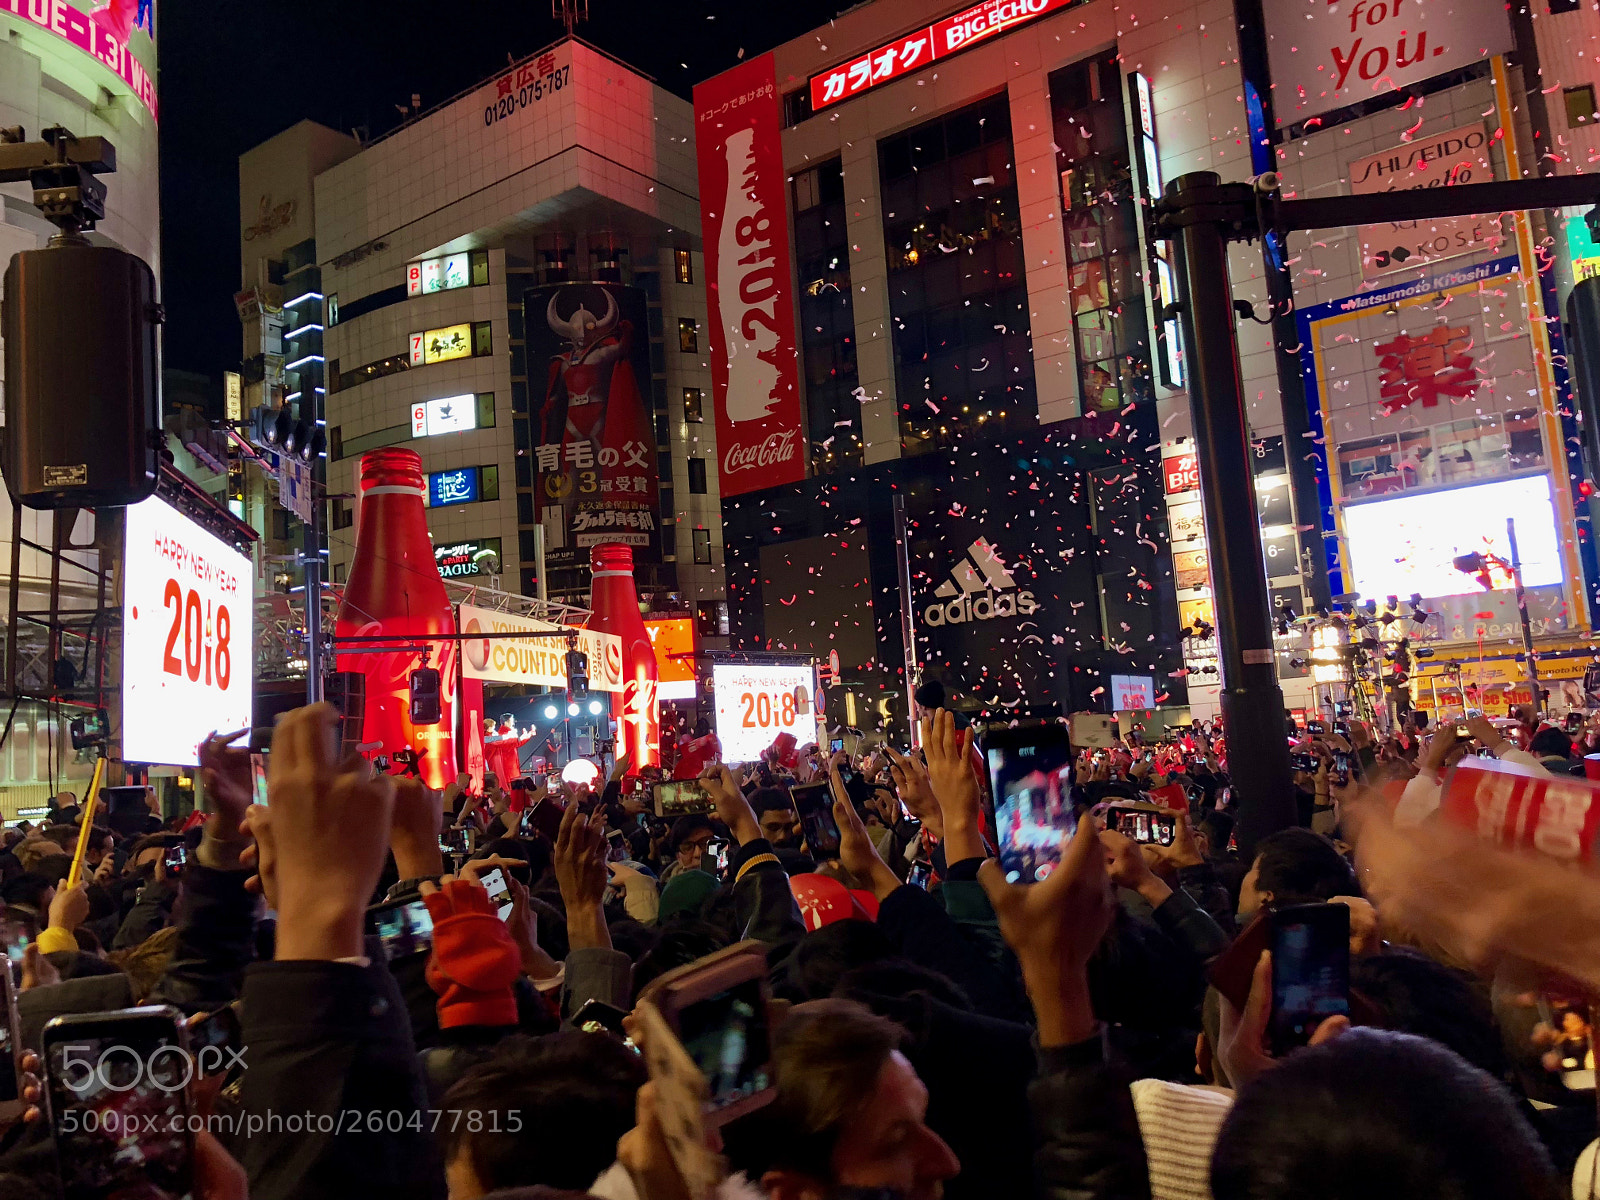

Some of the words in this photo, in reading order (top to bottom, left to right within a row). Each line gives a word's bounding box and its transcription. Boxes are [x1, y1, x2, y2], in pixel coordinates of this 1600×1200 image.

[946, 16, 986, 50] BIG
[988, 0, 1049, 26] ECHO
[496, 53, 556, 99] 貸広告
[822, 38, 926, 102] カラオケ
[485, 64, 570, 126] 0120-075-787
[1353, 132, 1484, 184] SHISEIDO
[535, 440, 649, 472] 育毛の父
[580, 471, 648, 493] 3冠受賞
[154, 530, 189, 571] HAPPY
[190, 552, 213, 583] NEW
[435, 543, 477, 559] ダーツバー
[438, 562, 479, 577] BAGUS
[924, 589, 1036, 627] adidas
[163, 578, 231, 691] 2018
[493, 645, 547, 675] COUNT
[741, 692, 795, 728] 2018
